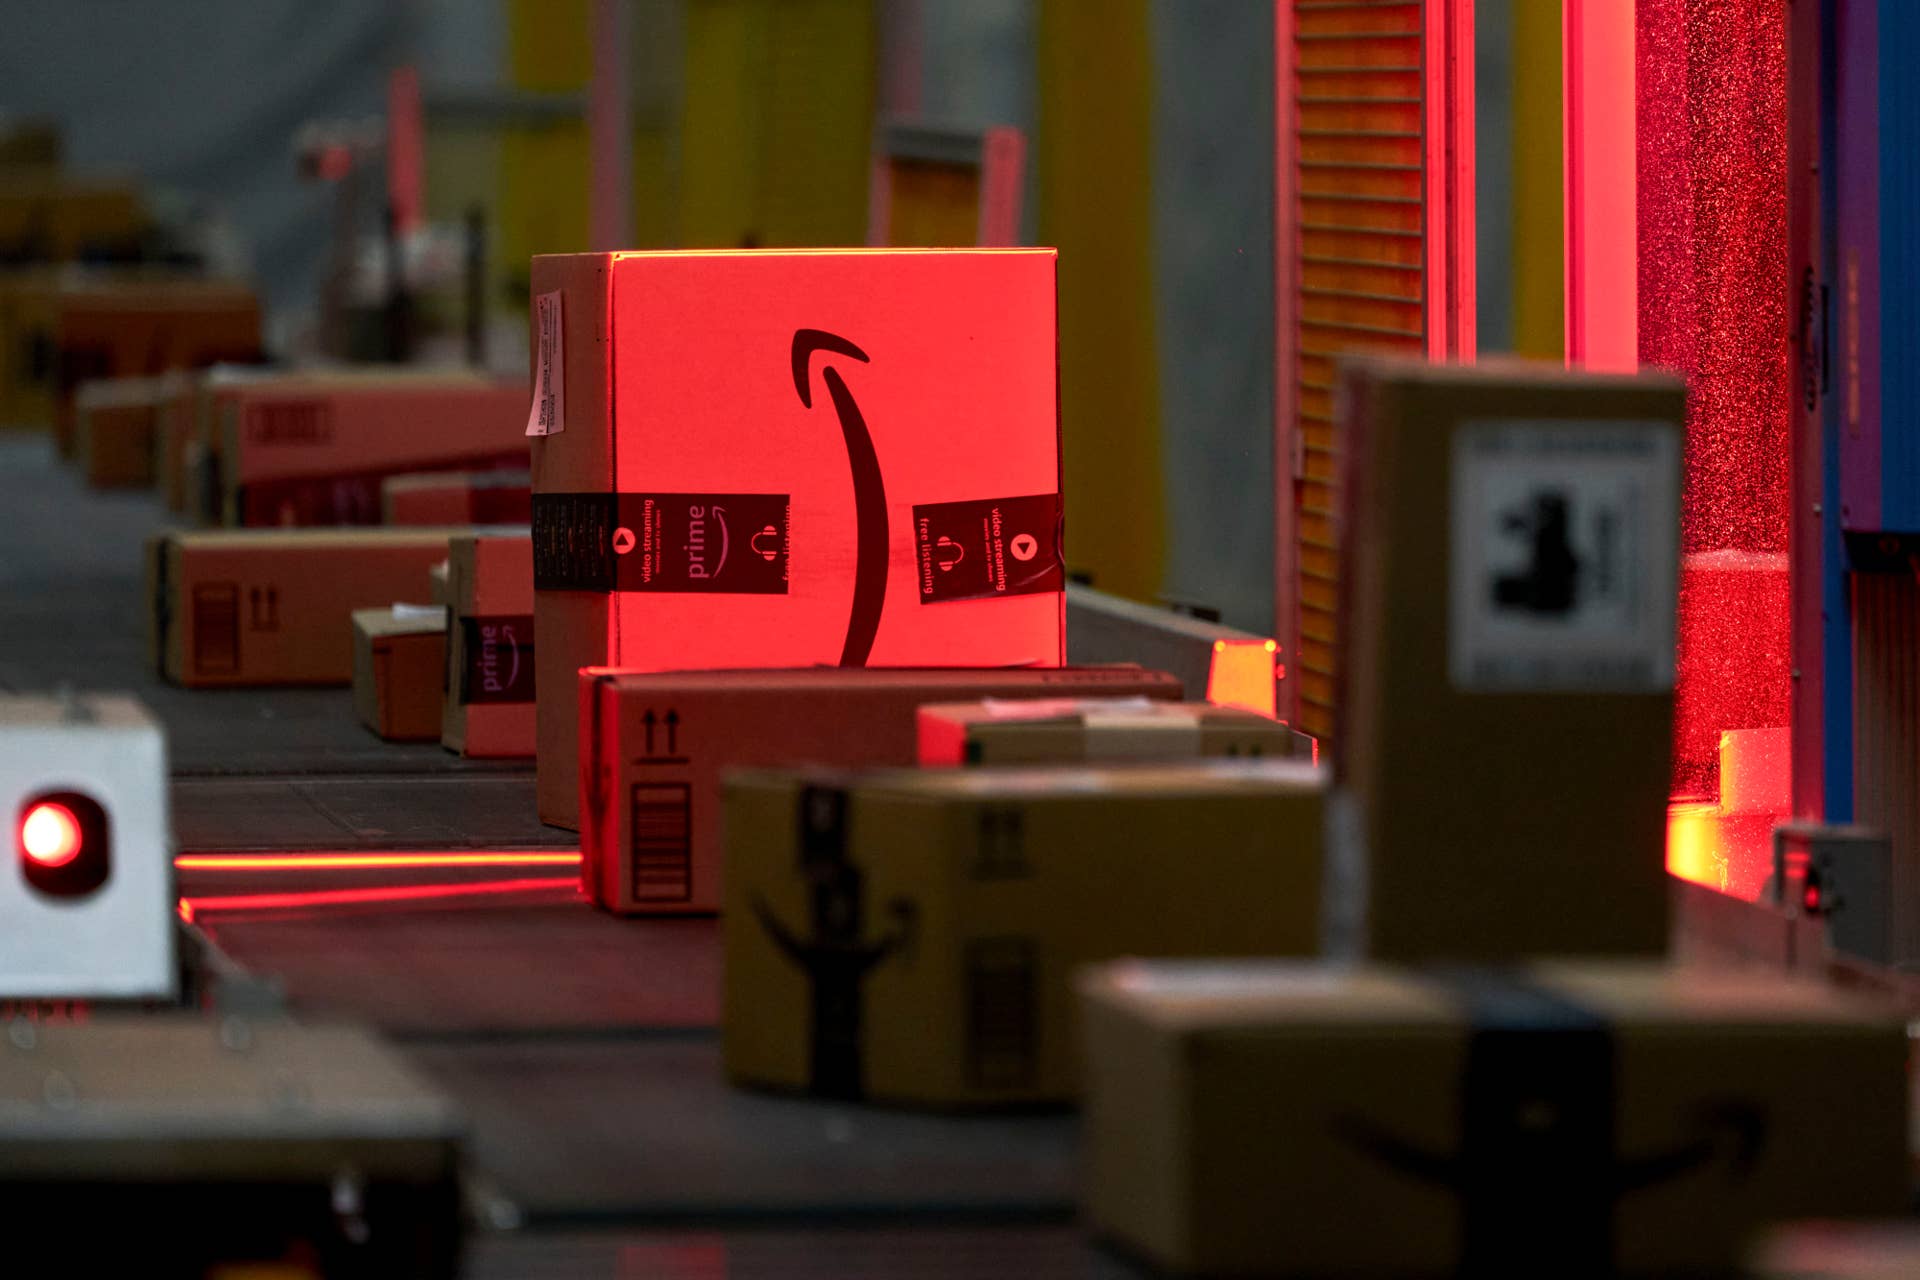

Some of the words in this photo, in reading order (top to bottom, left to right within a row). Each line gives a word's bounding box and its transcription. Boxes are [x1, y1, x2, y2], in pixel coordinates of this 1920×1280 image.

[641, 499, 655, 552] streaming
[683, 505, 710, 578] prime
[919, 518, 930, 541] free
[991, 508, 1002, 537] video
[642, 554, 652, 583] video
[921, 543, 934, 594] listening
[994, 539, 1007, 592] streaming
[476, 625, 503, 692] prime
